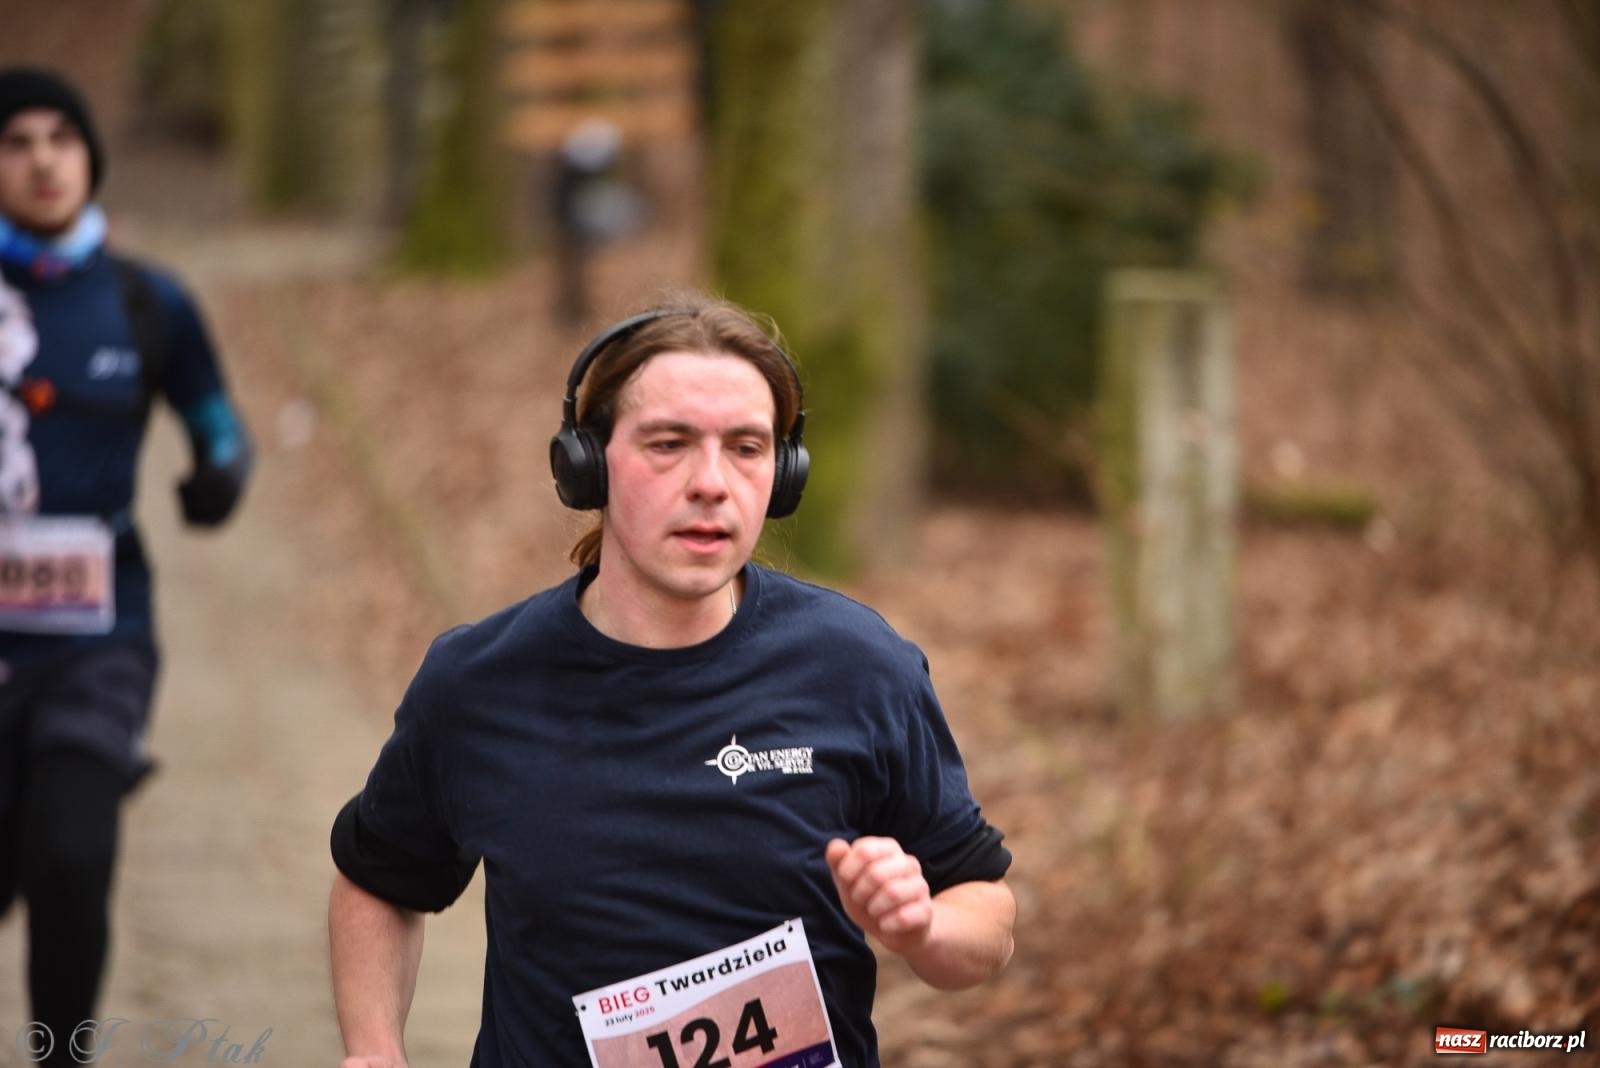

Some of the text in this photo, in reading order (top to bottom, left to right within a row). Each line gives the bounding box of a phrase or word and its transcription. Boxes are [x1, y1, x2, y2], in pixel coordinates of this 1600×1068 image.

[599, 937, 788, 1015] BIEG Twardziela
[615, 1012, 634, 1024] luty
[646, 998, 778, 1068] 124
